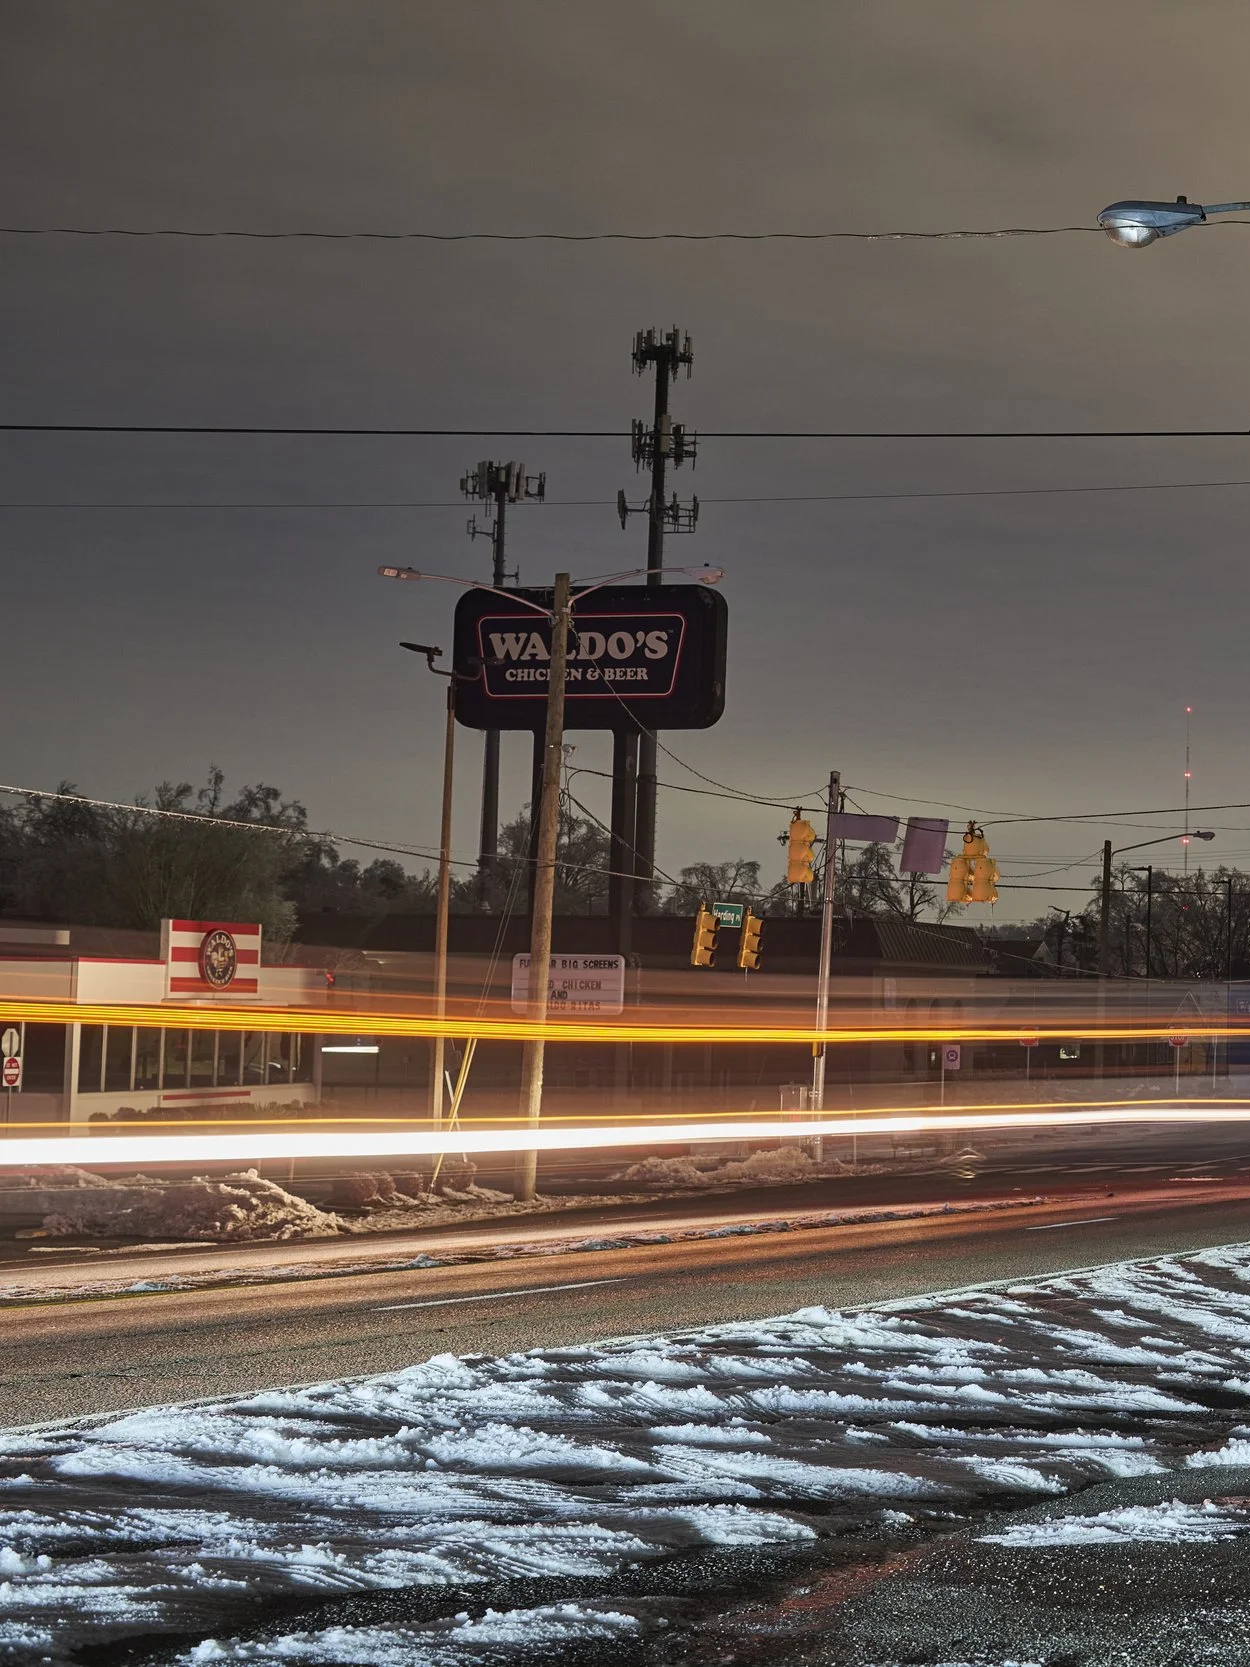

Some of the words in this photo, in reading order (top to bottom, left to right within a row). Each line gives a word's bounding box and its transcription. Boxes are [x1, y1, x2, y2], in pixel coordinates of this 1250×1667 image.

[505, 669, 582, 681] CHICEN
[586, 668, 599, 681] &
[603, 668, 648, 680] BEER
[583, 960, 619, 969] SCREENS
[562, 981, 602, 990] CHICKEN
[551, 990, 568, 999] AND
